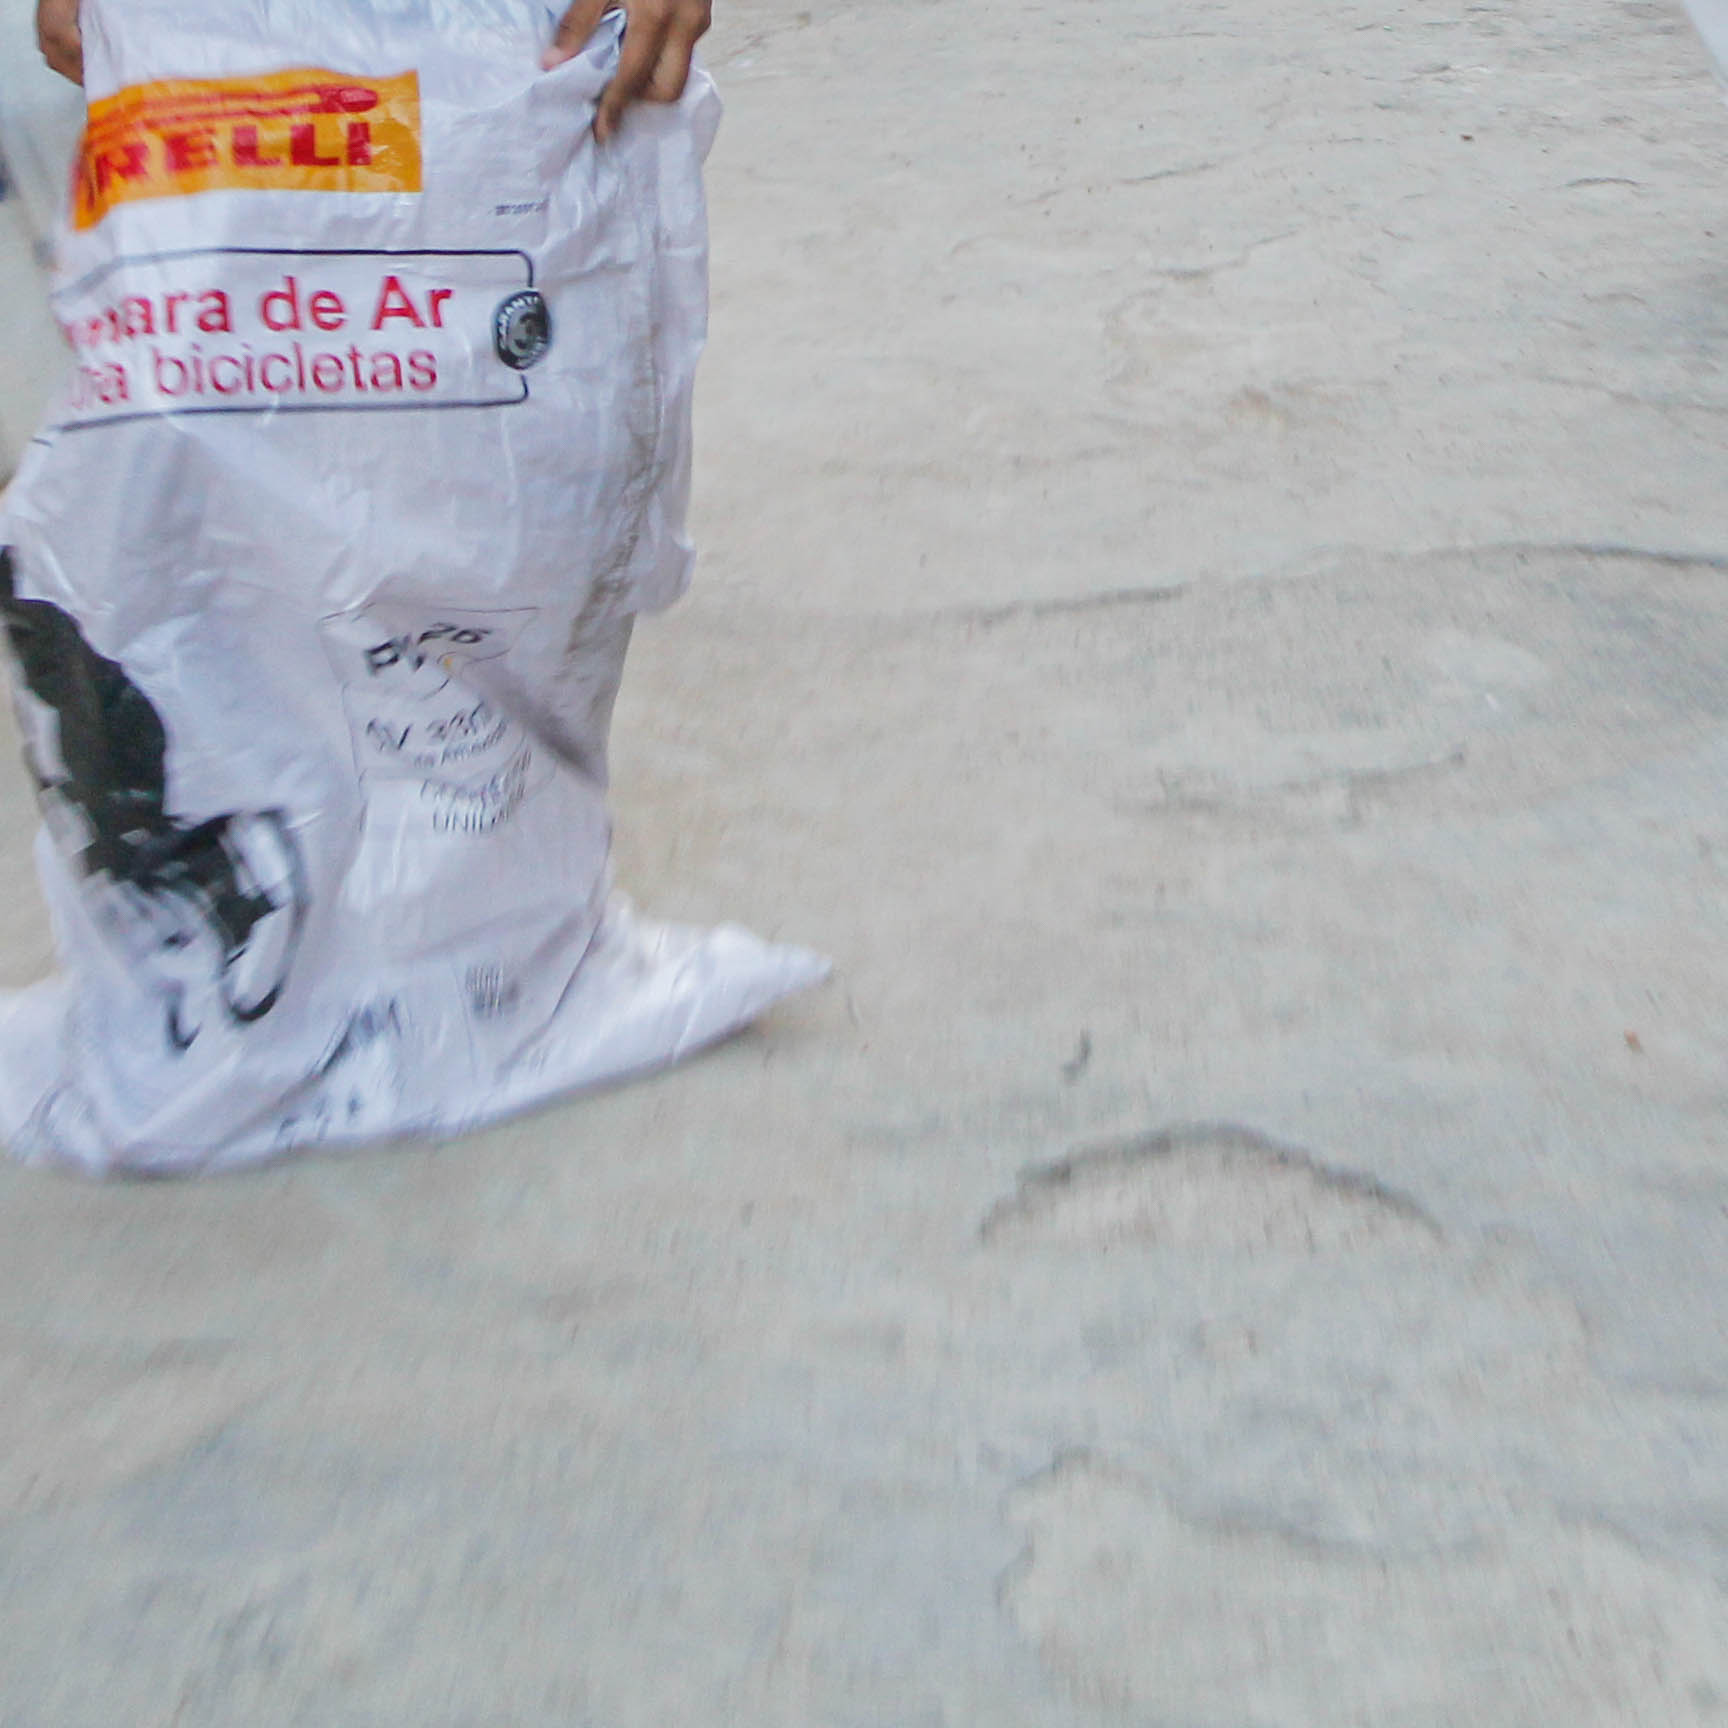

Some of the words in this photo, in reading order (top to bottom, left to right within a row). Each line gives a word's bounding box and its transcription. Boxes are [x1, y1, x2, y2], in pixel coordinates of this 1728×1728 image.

[260, 274, 348, 332] de
[369, 275, 452, 330] Ar
[154, 342, 439, 395] bicicletas
